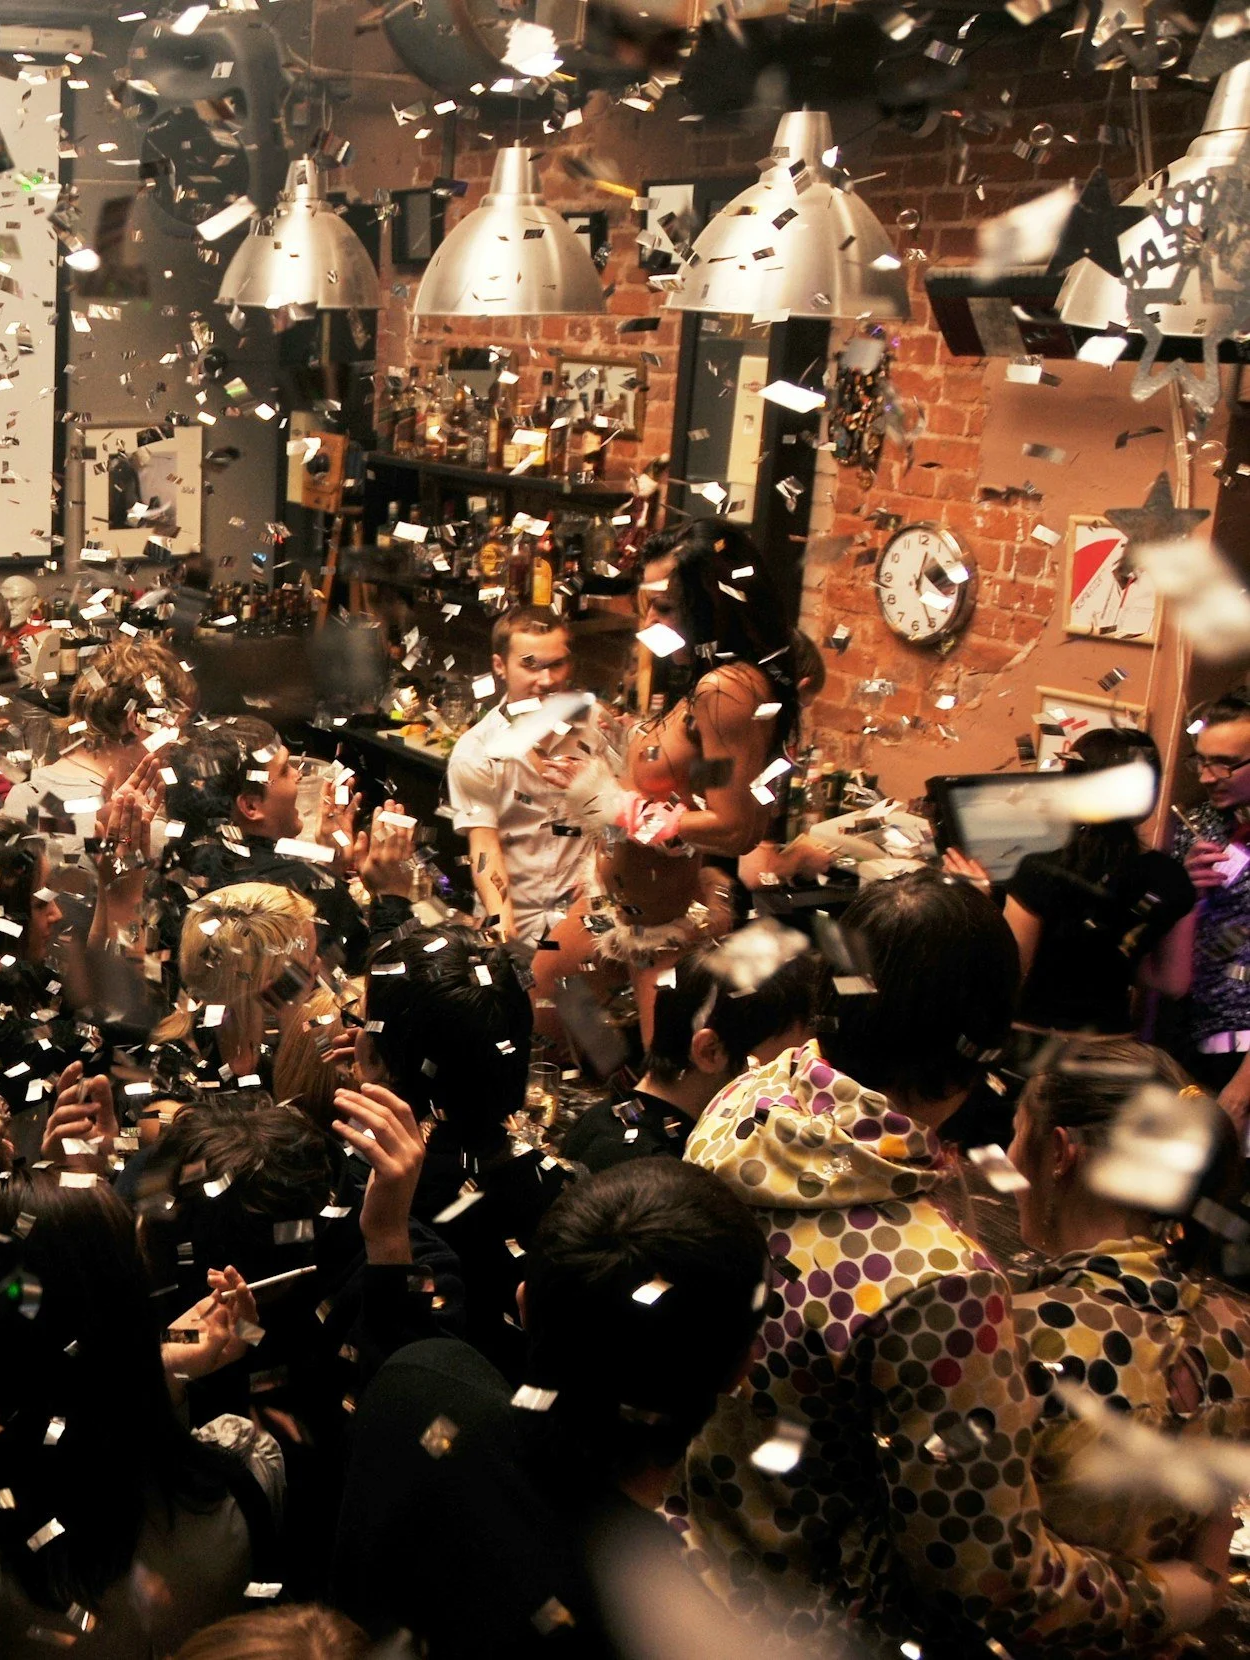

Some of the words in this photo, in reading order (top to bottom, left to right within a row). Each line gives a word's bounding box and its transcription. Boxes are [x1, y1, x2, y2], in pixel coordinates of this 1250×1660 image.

[903, 539, 911, 550] 11
[919, 534, 930, 546] 12
[891, 552, 900, 563] 10
[884, 571, 893, 583] 9
[887, 594, 896, 605] 8
[897, 611, 905, 622] 7
[911, 620, 920, 632] 6
